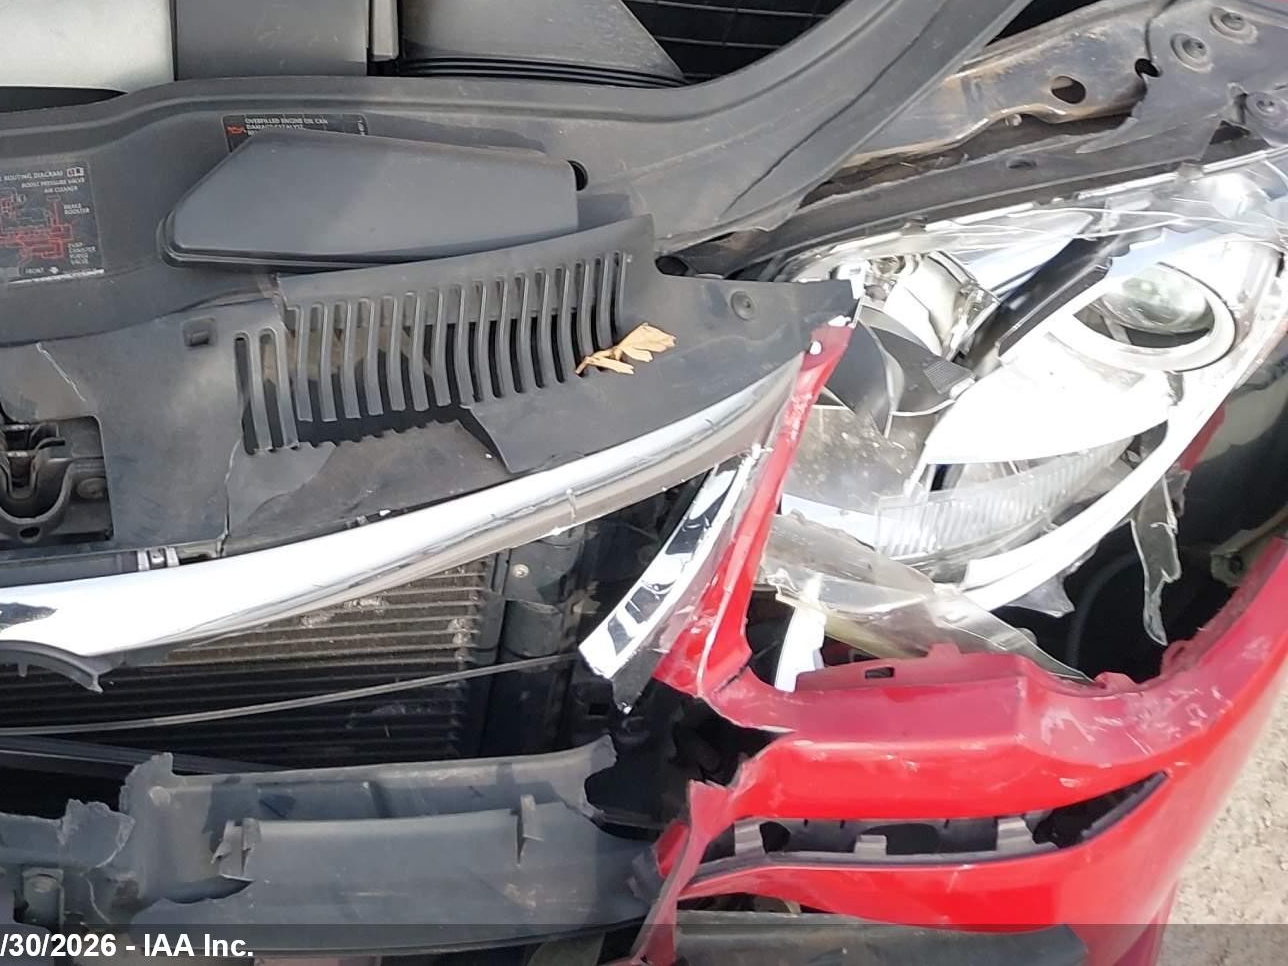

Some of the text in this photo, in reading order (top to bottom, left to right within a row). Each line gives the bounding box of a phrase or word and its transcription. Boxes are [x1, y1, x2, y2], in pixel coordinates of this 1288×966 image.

[4, 174, 32, 182] ROUTING
[33, 171, 63, 179] DIAGRAM
[55, 185, 78, 193] CLEANER
